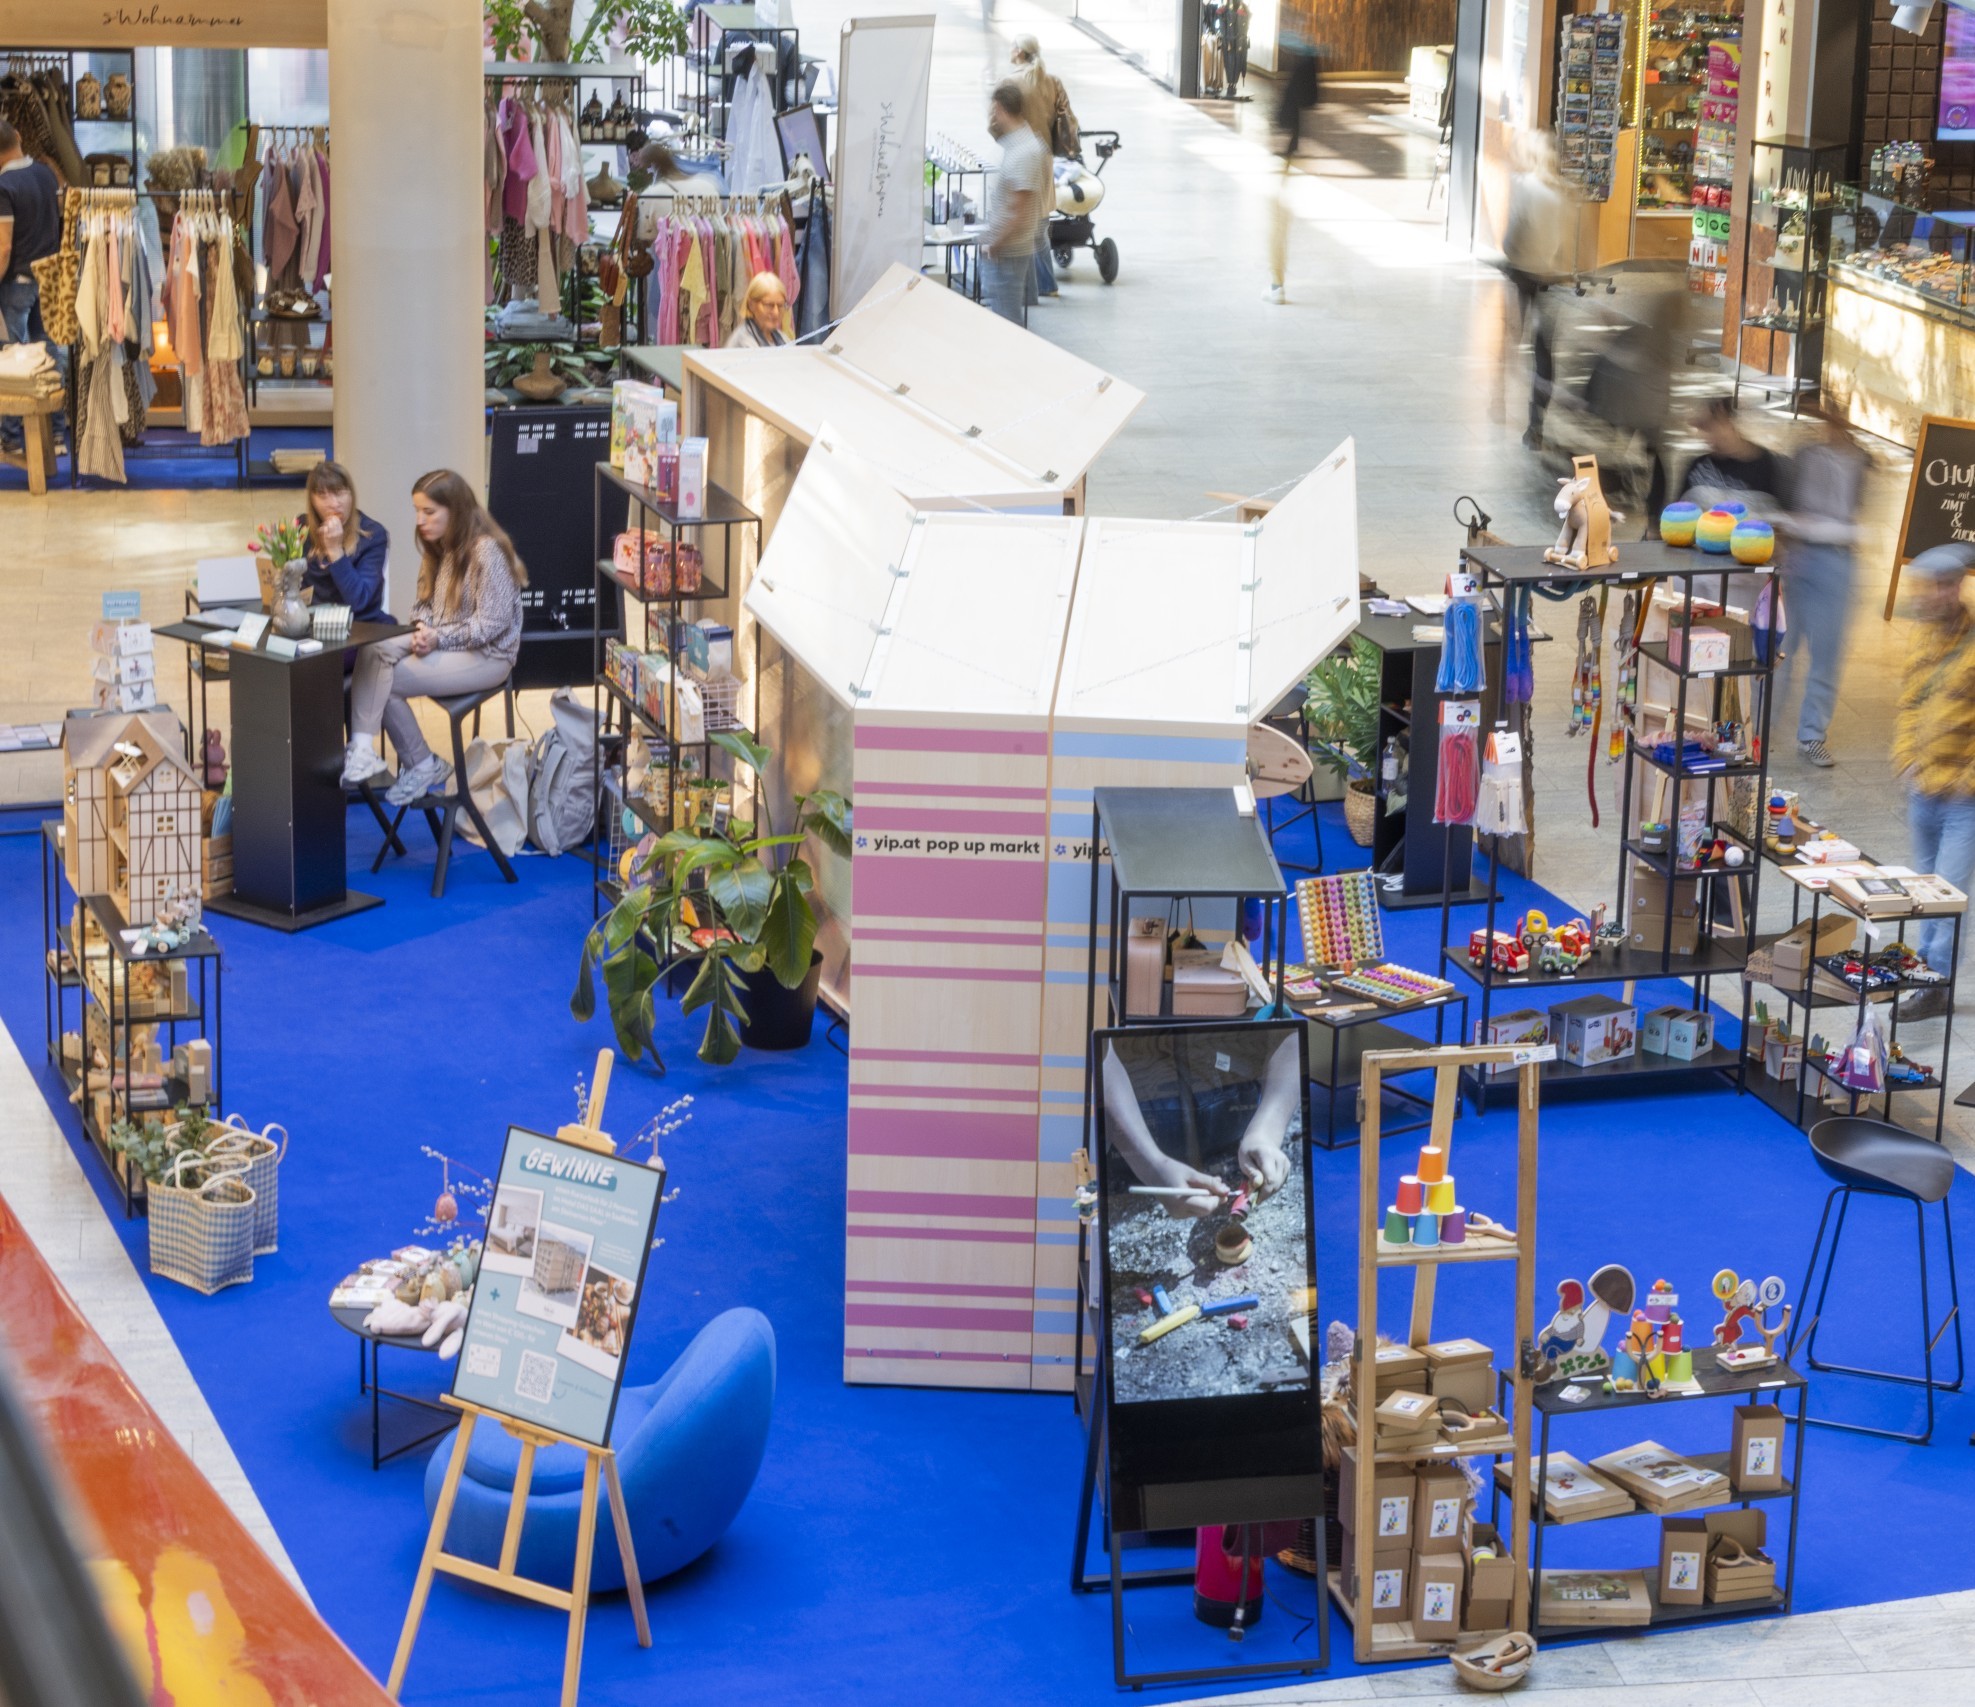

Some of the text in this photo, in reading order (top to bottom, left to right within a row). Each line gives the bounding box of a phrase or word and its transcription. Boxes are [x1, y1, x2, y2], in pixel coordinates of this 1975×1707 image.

[1940, 498, 1966, 513] ZIMT
[1950, 511, 1963, 528] &
[874, 835, 1040, 855] yip.at pop up markt
[525, 1147, 615, 1187] GEWINNE
